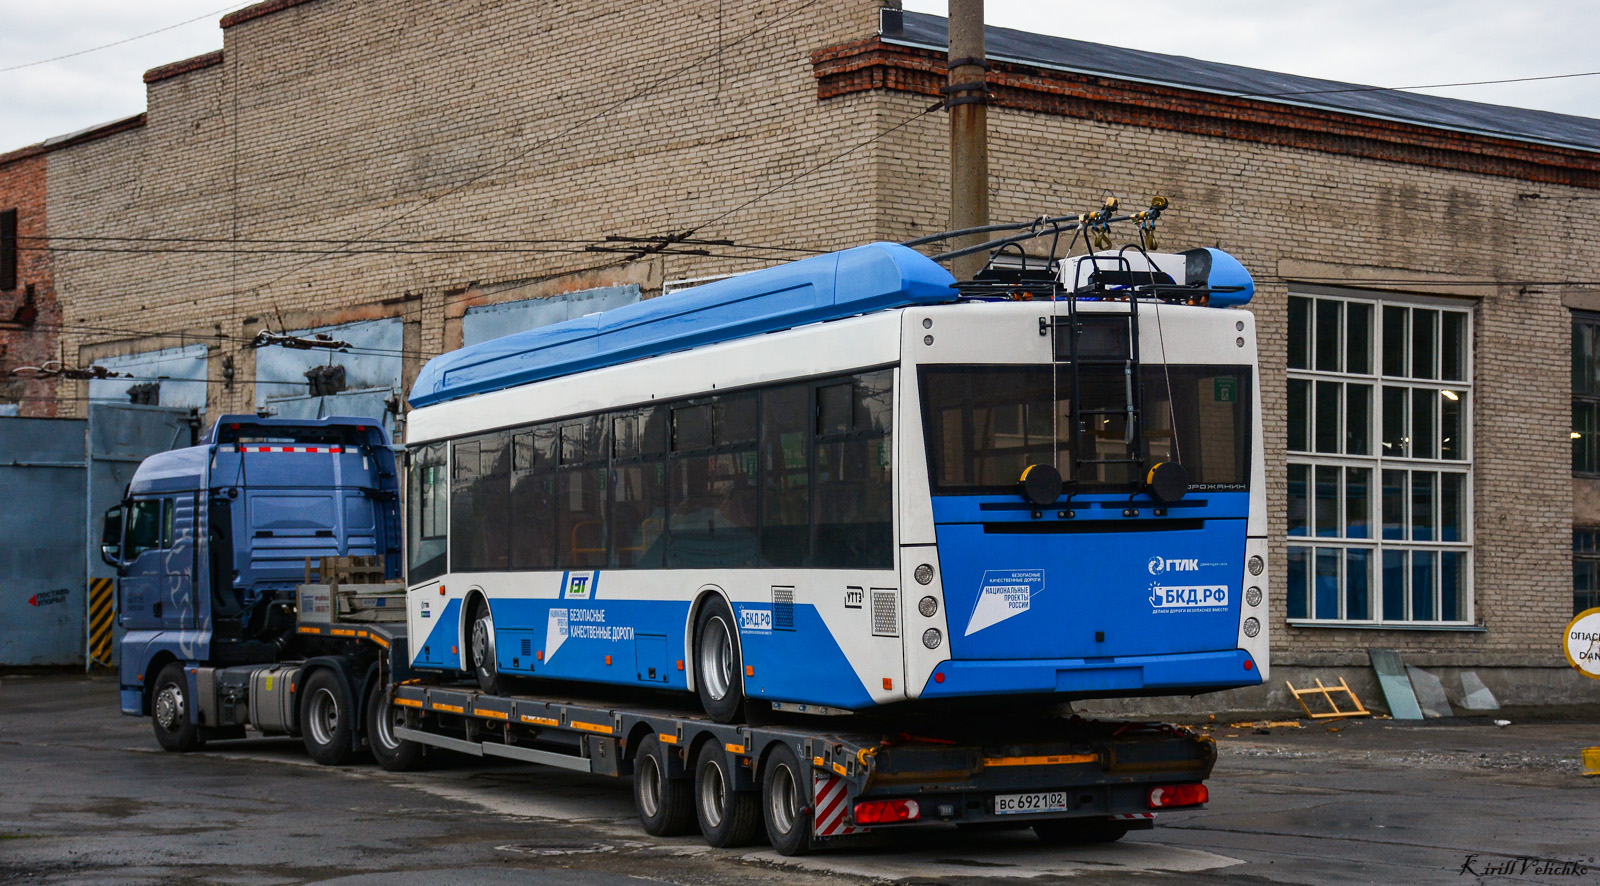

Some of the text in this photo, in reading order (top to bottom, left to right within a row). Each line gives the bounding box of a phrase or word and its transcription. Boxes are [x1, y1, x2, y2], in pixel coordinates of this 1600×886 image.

[1165, 558, 1199, 572] ГТЛК
[846, 591, 862, 603] УТТЗ
[985, 586, 1029, 595] НАЦИОНАЛЬНЫЕ
[1165, 587, 1226, 605] БКД.РФ
[1003, 594, 1029, 602] ПРОЕКТЫ
[1008, 601, 1029, 609] РОССИИ
[569, 608, 606, 622] БЕЗОПАСНЫЕ
[745, 611, 771, 628] БКД.РФ
[570, 625, 612, 640] КАЧЕСТВЕННЫЕ
[612, 626, 635, 642] ДОРОГИ
[1570, 631, 1600, 641] ОПАС
[1017, 794, 1048, 809] 6921
[1050, 793, 1063, 804] 02
